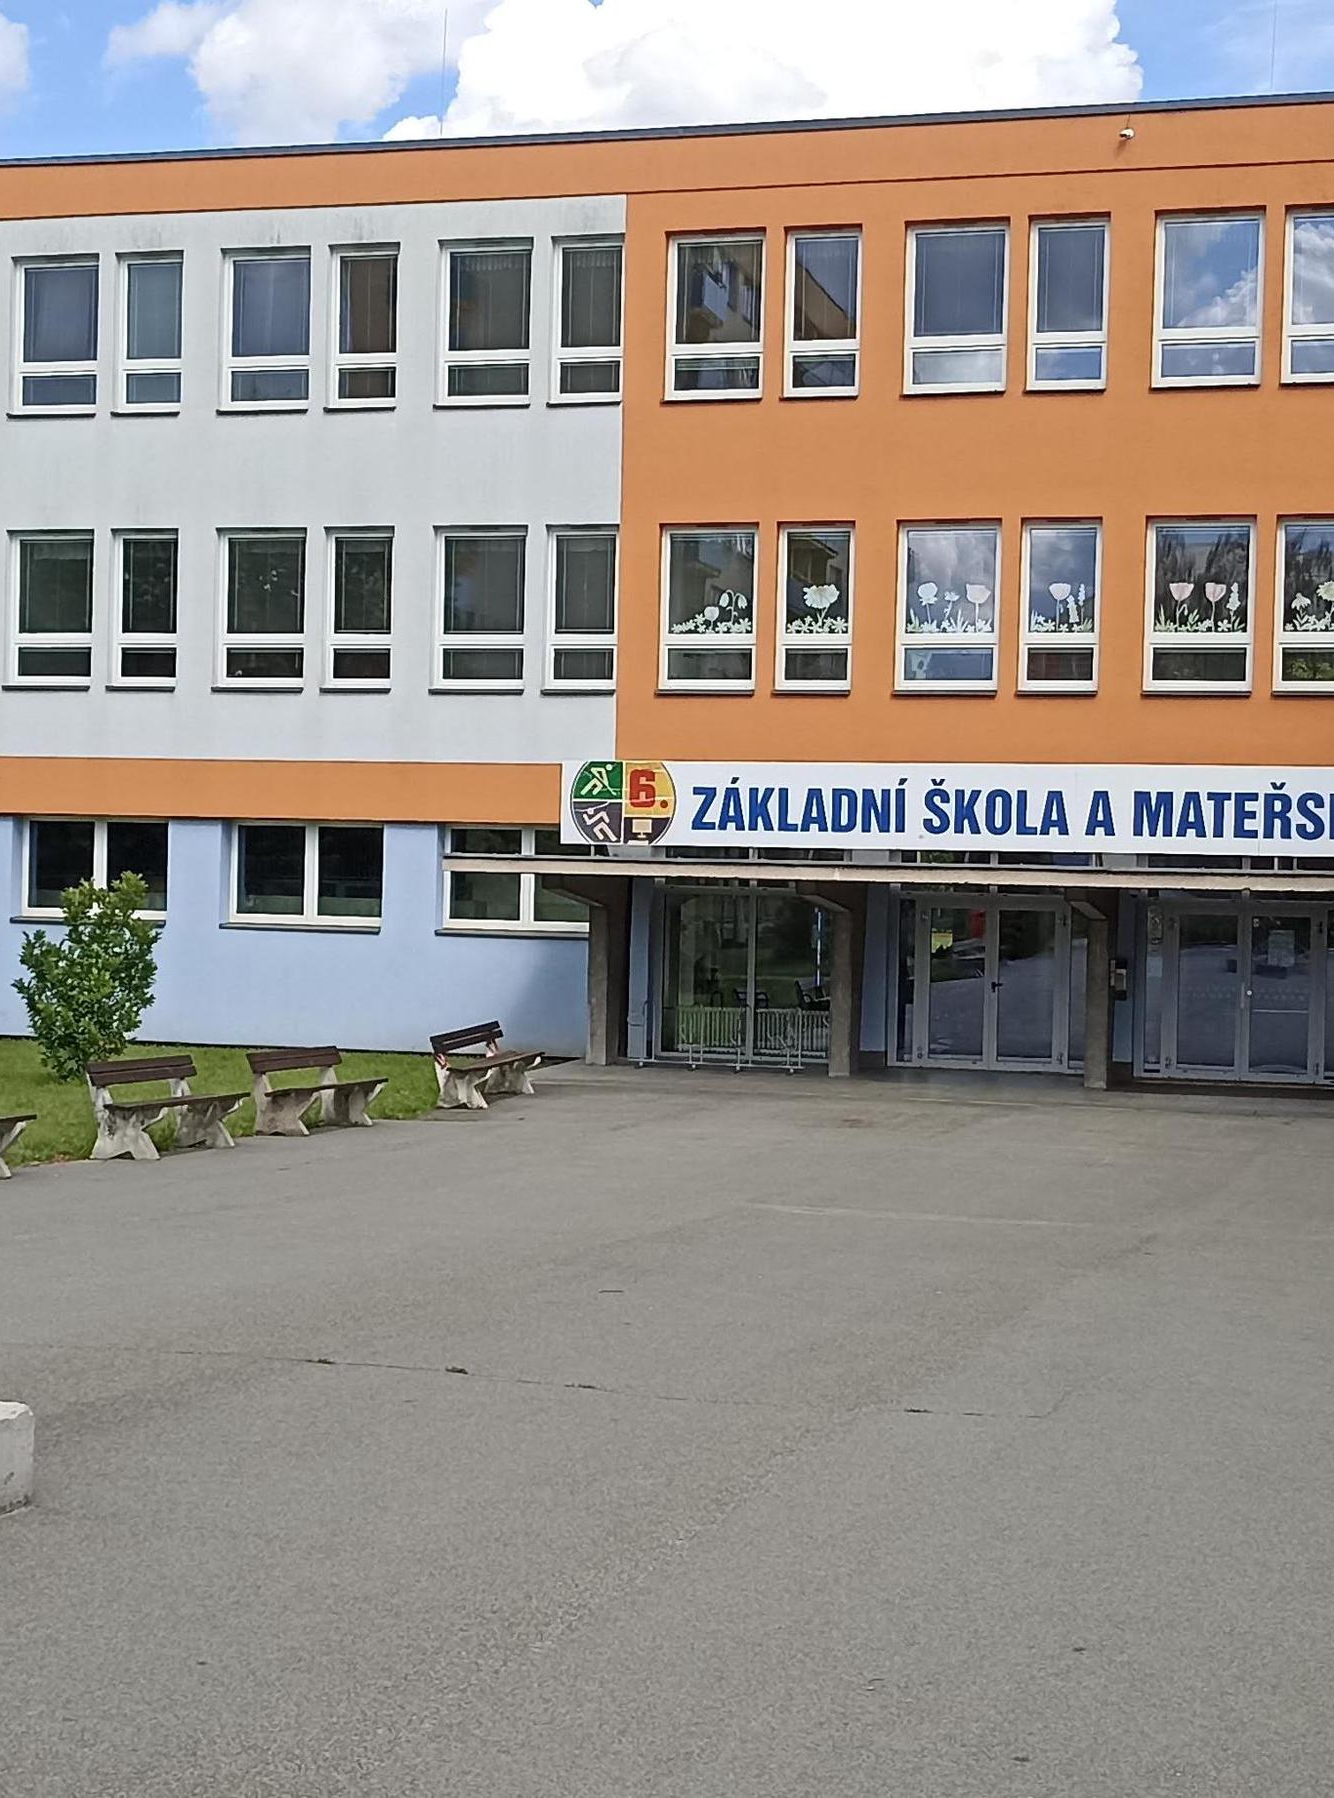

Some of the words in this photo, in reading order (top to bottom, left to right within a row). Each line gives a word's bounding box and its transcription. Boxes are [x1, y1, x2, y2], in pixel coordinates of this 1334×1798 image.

[630, 769, 668, 808] 6.
[692, 777, 908, 833] ZÁKLADNÍ
[923, 779, 1070, 836] ŠKOLA
[1085, 791, 1115, 837] A
